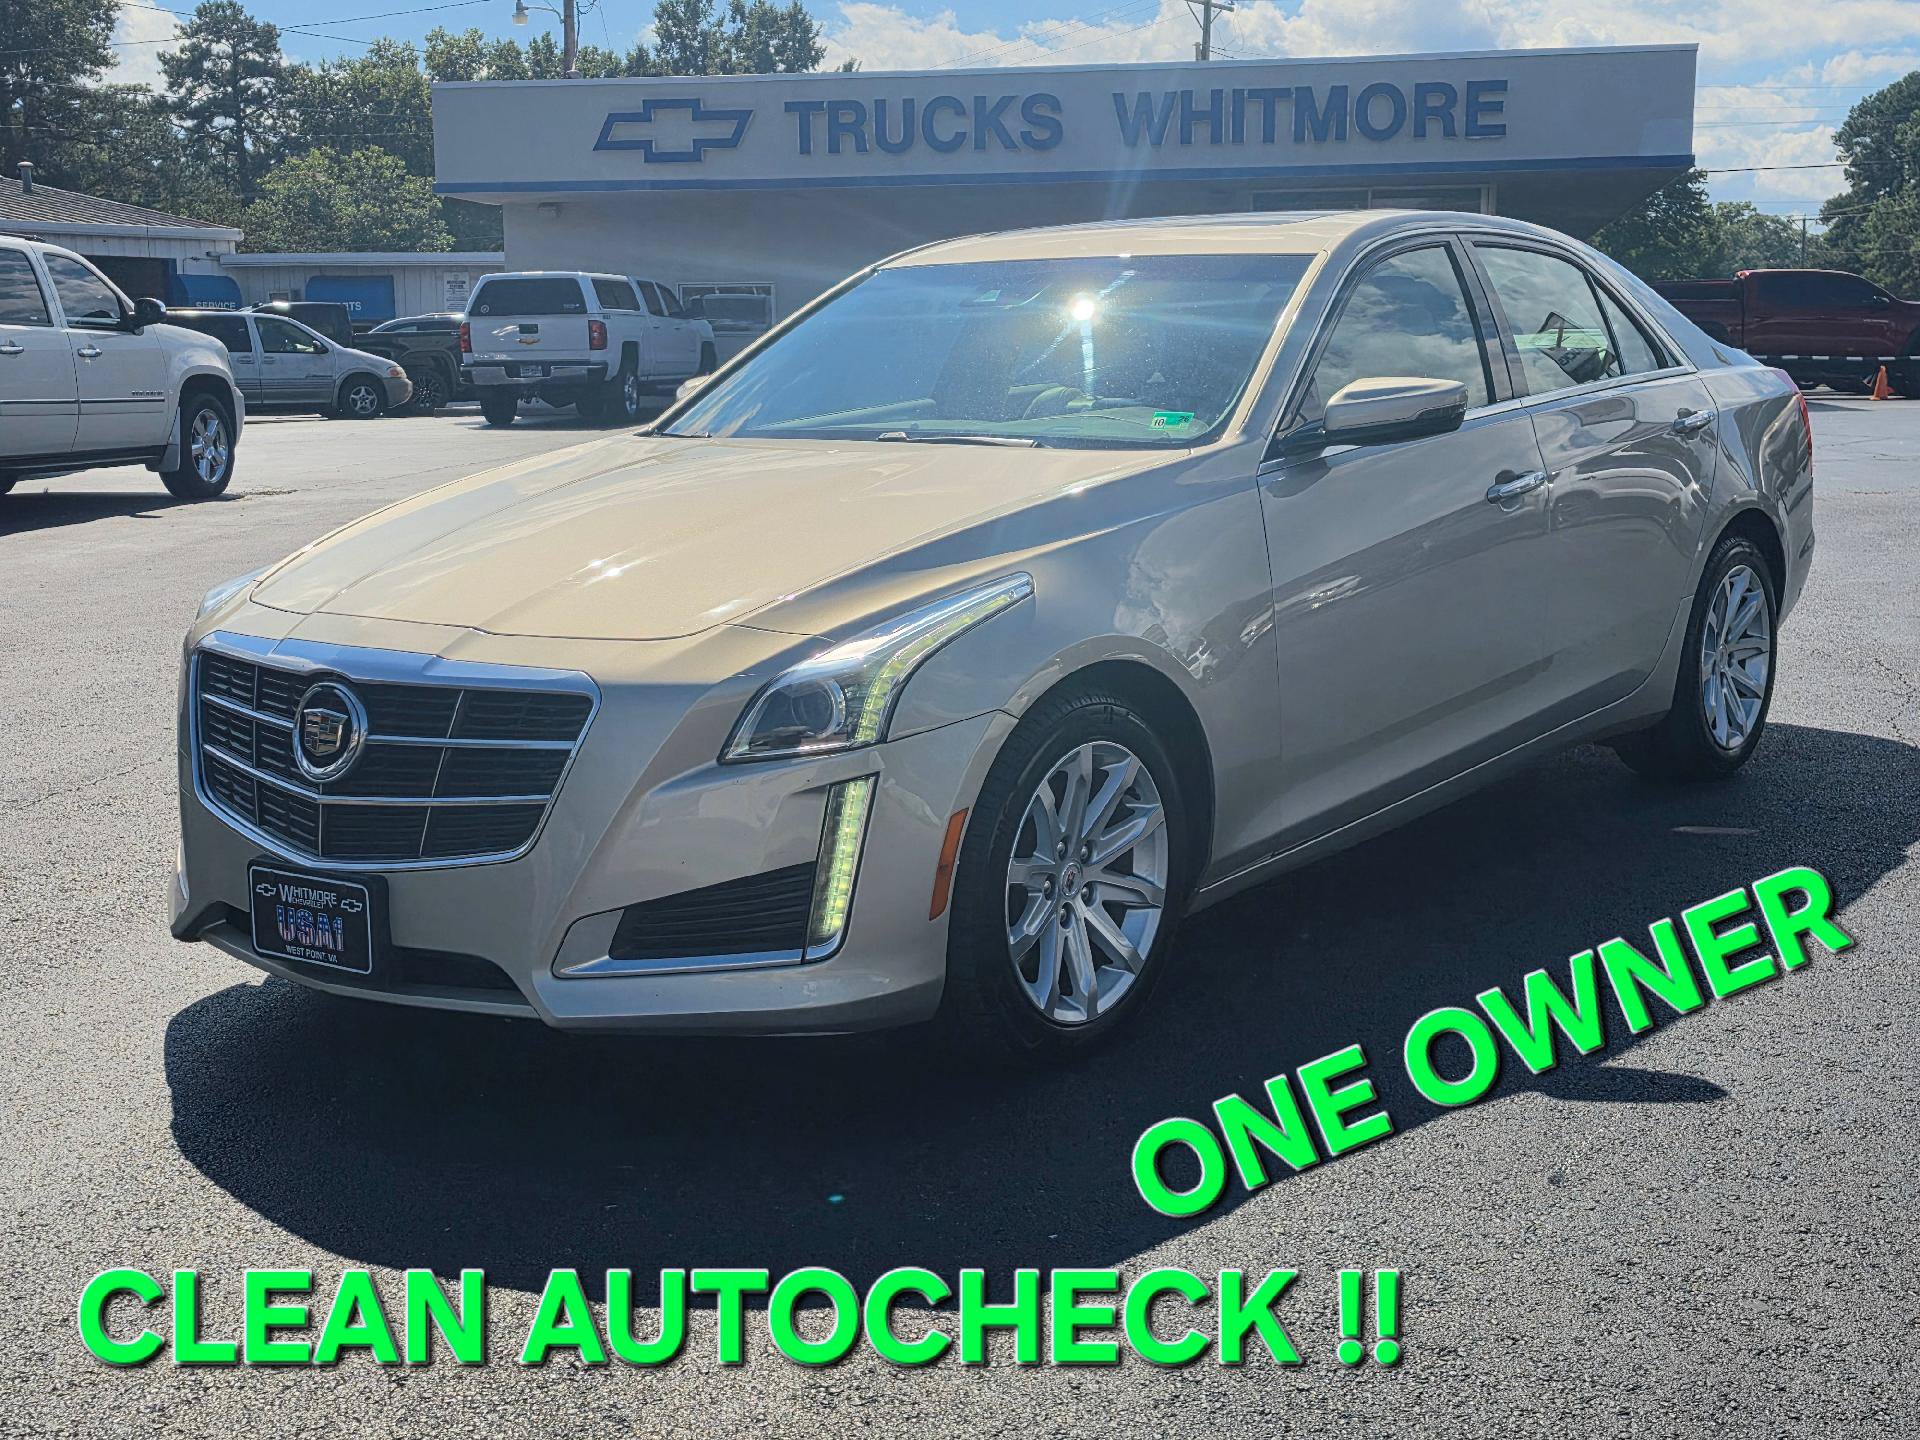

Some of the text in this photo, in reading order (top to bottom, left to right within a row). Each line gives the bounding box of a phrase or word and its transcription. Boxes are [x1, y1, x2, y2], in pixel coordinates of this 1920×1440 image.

[783, 79, 1509, 156] TRUCKS WHITMORE
[1154, 418, 1165, 427] 10
[278, 883, 337, 908] WHITMORE
[292, 897, 325, 909] CHEVROLET
[286, 945, 304, 956] WEST
[327, 953, 338, 963] VA
